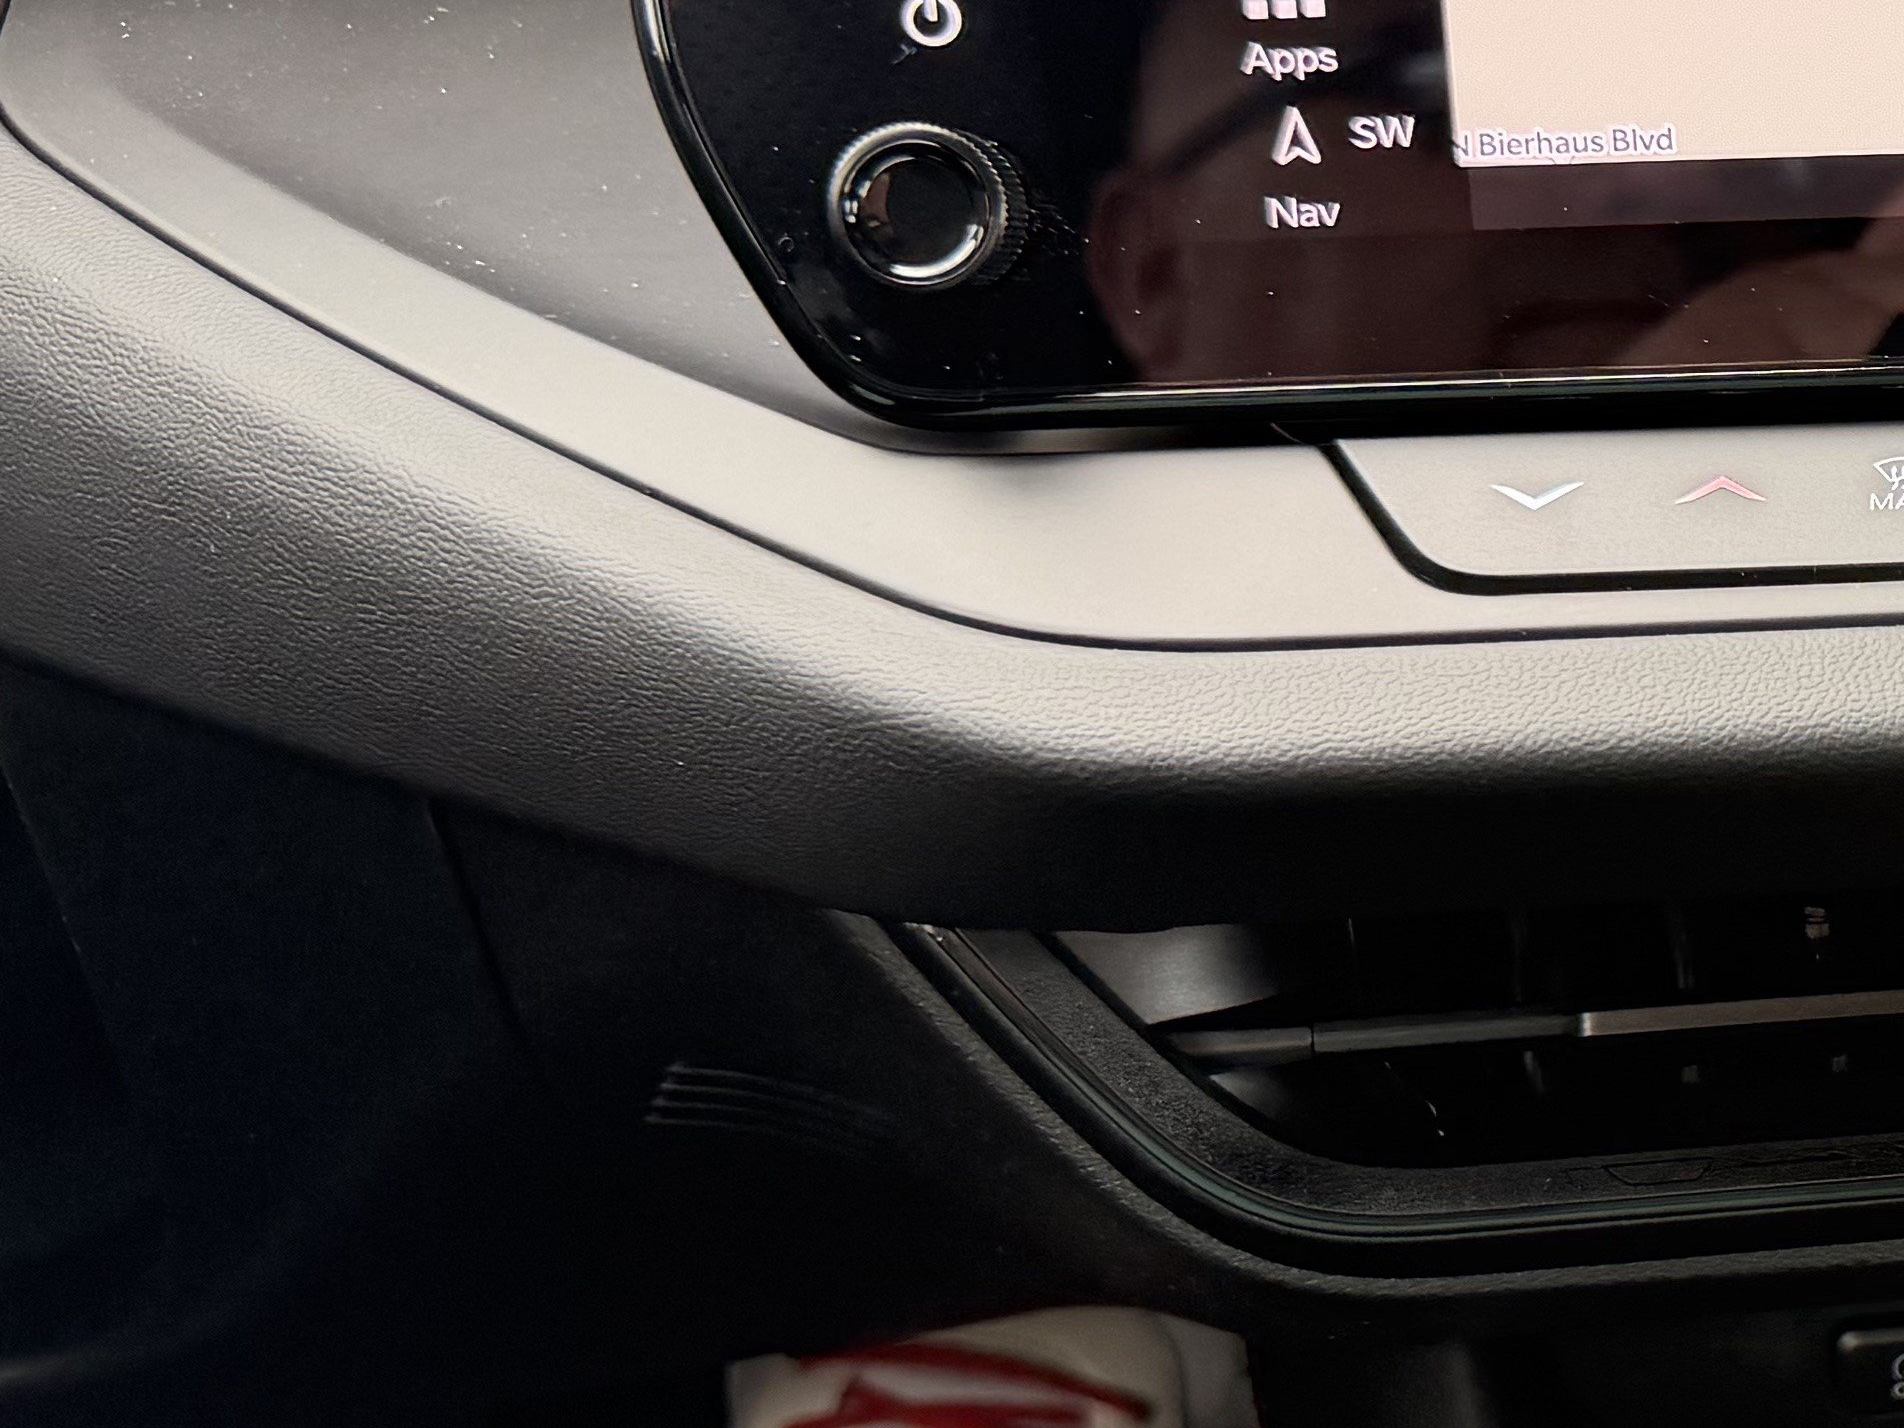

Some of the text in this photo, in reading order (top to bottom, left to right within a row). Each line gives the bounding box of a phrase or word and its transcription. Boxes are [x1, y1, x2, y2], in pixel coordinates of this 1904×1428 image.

[1240, 43, 1338, 81] Apps
[1348, 115, 1415, 150] SW
[1479, 131, 1604, 157] Bierhaus
[1612, 127, 1673, 152] Blvd
[1264, 197, 1340, 230] Nav
